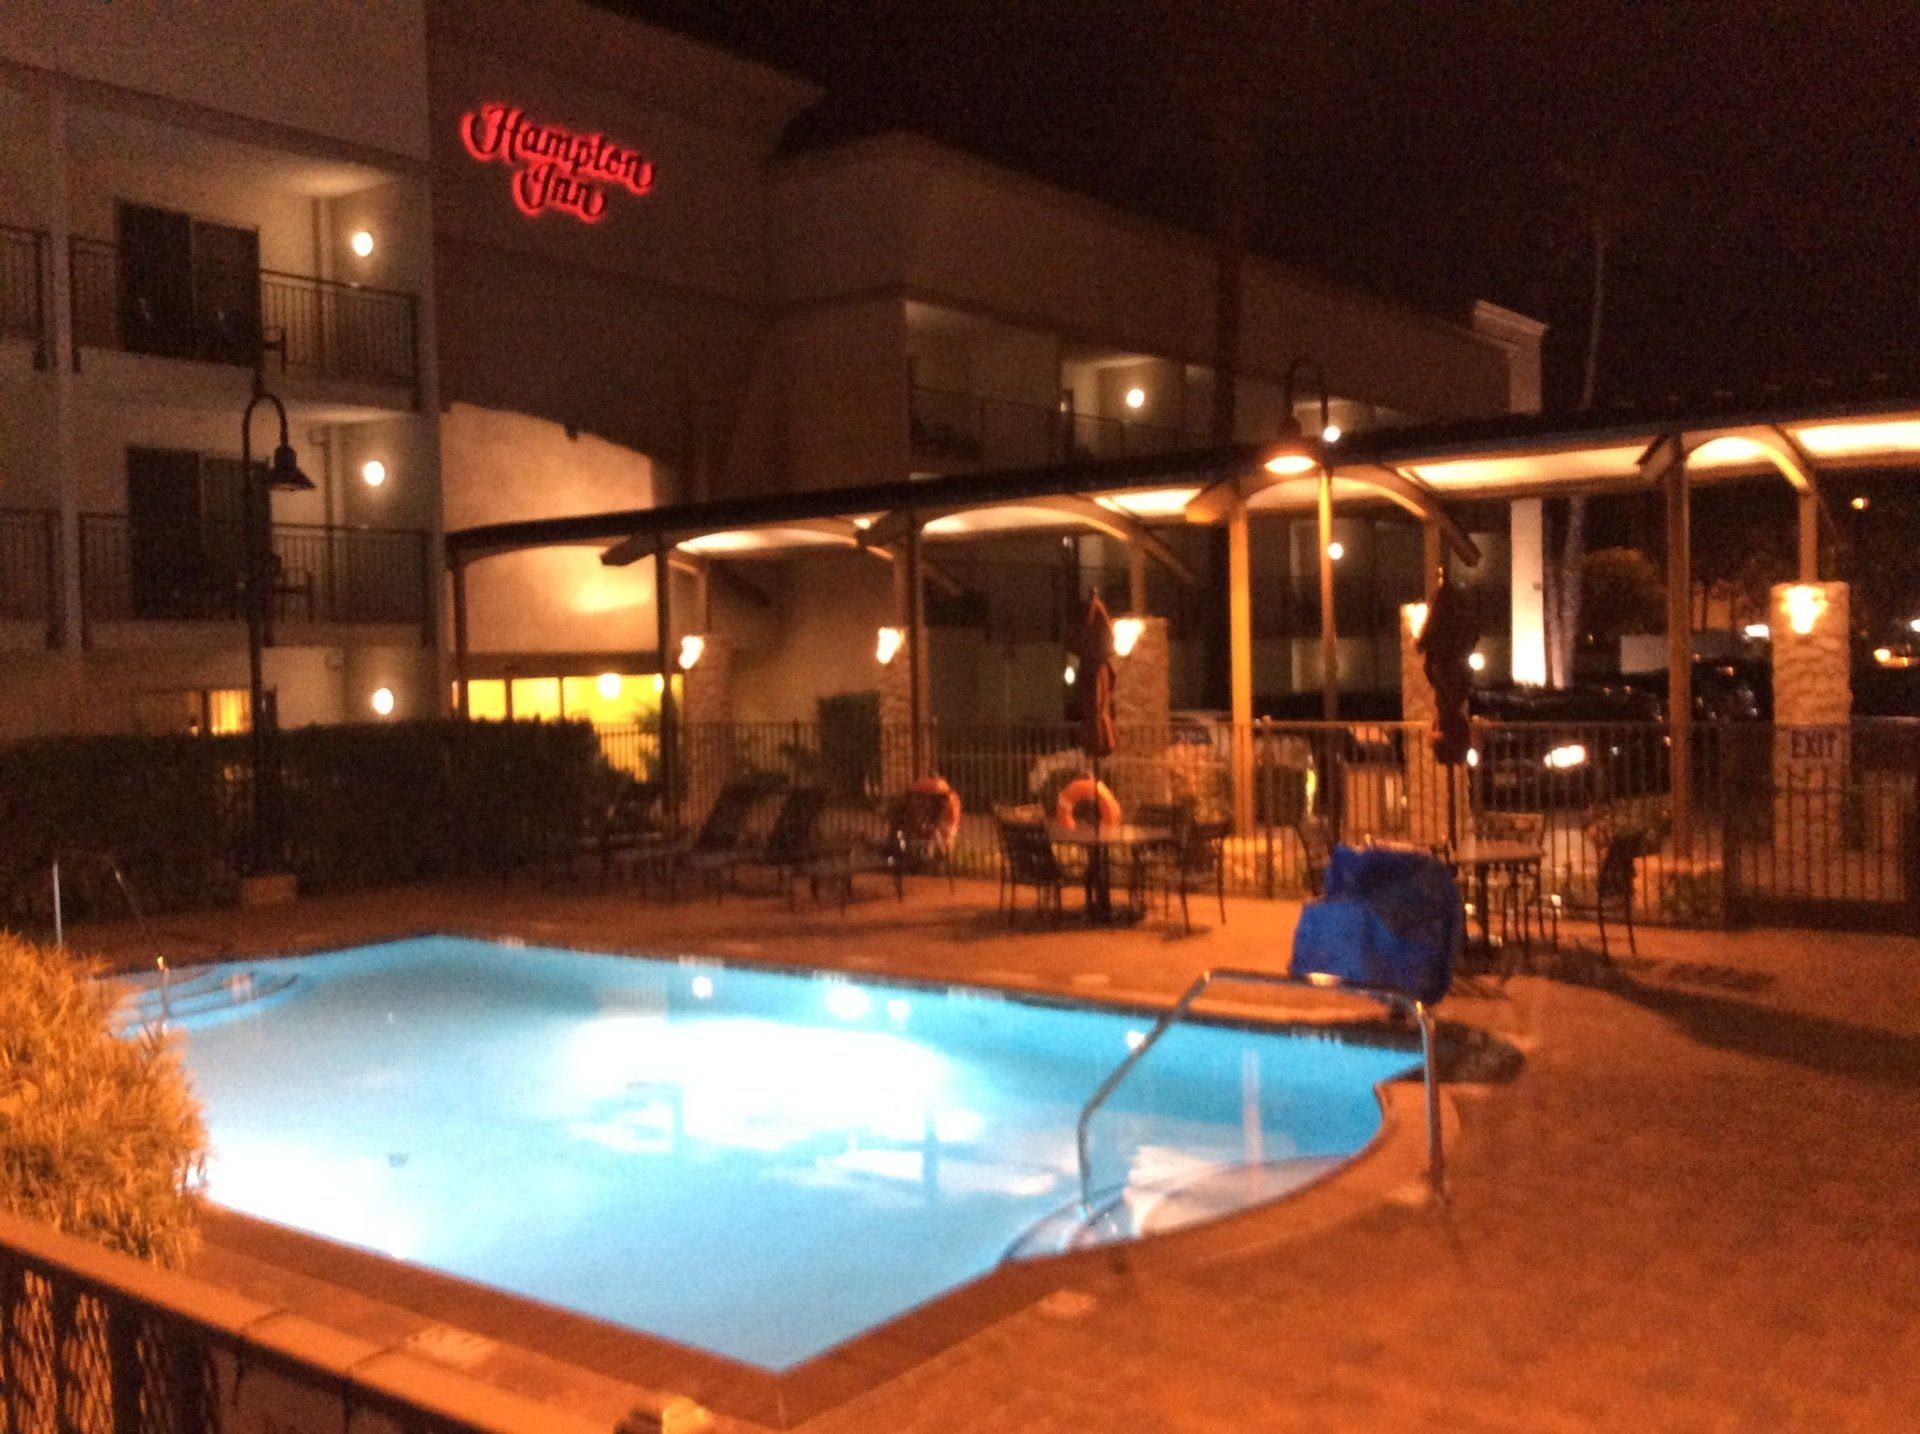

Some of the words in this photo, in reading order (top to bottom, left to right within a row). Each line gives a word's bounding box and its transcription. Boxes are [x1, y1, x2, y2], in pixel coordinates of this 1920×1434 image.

[463, 104, 655, 193] Hampton
[513, 160, 607, 221] Inn
[1791, 729, 1837, 759] EXIT
